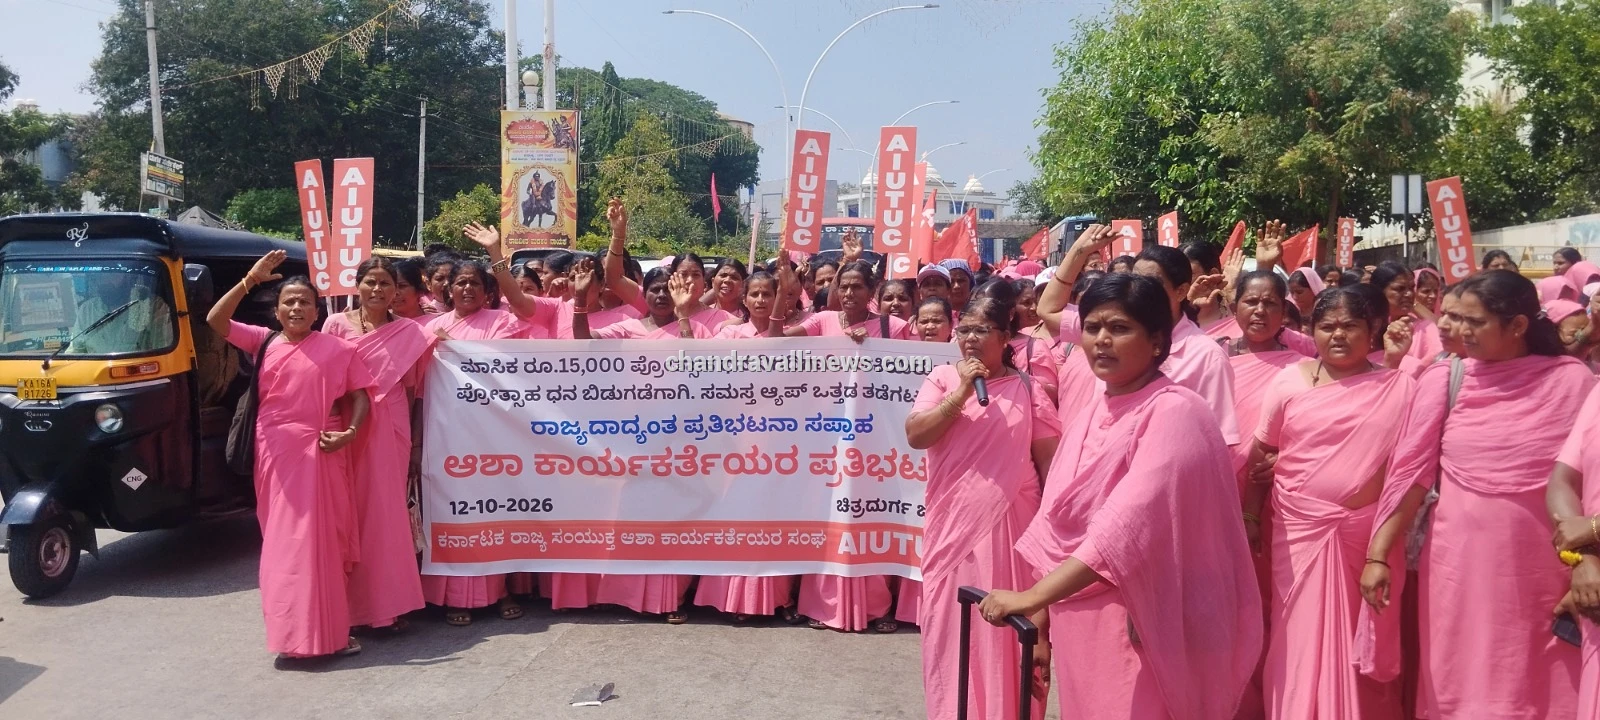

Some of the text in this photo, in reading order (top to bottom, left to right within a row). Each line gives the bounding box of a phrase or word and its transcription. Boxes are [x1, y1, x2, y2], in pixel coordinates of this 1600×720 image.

[792, 138, 822, 246] AIUTUC
[882, 134, 909, 246] AIUTUC
[302, 169, 331, 290] AIUTUC
[339, 167, 366, 287] AIUTUC
[1340, 221, 1351, 265] AIUTUC
[1436, 185, 1470, 278] AIUTUC
[460, 358, 519, 374] ಮಾಸಿಕ
[523, 357, 625, 377] ರೂ.15,000
[24, 390, 52, 398] B1726
[456, 382, 541, 407] ಪ್ರೋತ್ಸಾಹ
[546, 385, 577, 404] ಧನ
[582, 383, 695, 401] ಬಿಡುಗಡೆಗಾಗಿ.
[701, 382, 757, 405] ಸಮಸ್ತ
[813, 382, 858, 404] ಒತ್ತಡ
[863, 382, 918, 403] ತಡೆಗಟ
[530, 412, 874, 445] ರಾಜ್ಯದಾದ್ಯಂತ ಪ್ರತಿಭಟನಾ ಸಪ್ತಾಹ
[443, 444, 928, 488] ಆಶಾ ಕಾರ್ಯಕರ್ತೆಯರ ಪ್ರತಿಭಟ
[449, 498, 553, 516] 12-10-2026
[836, 497, 912, 518] ಚಿತ್ರದುರ್ಗ
[438, 529, 505, 548] ಕರ್ನಾಟಕ
[510, 530, 548, 552] ರಾಜ್ಯ
[551, 528, 616, 550] ಸಂಯುಕ್ತ
[620, 529, 655, 545] ಆಶಾ
[660, 528, 782, 546] ಕಾರ್ಯಕರ್ತೆಯರ
[787, 529, 827, 548] ಸಂಘ
